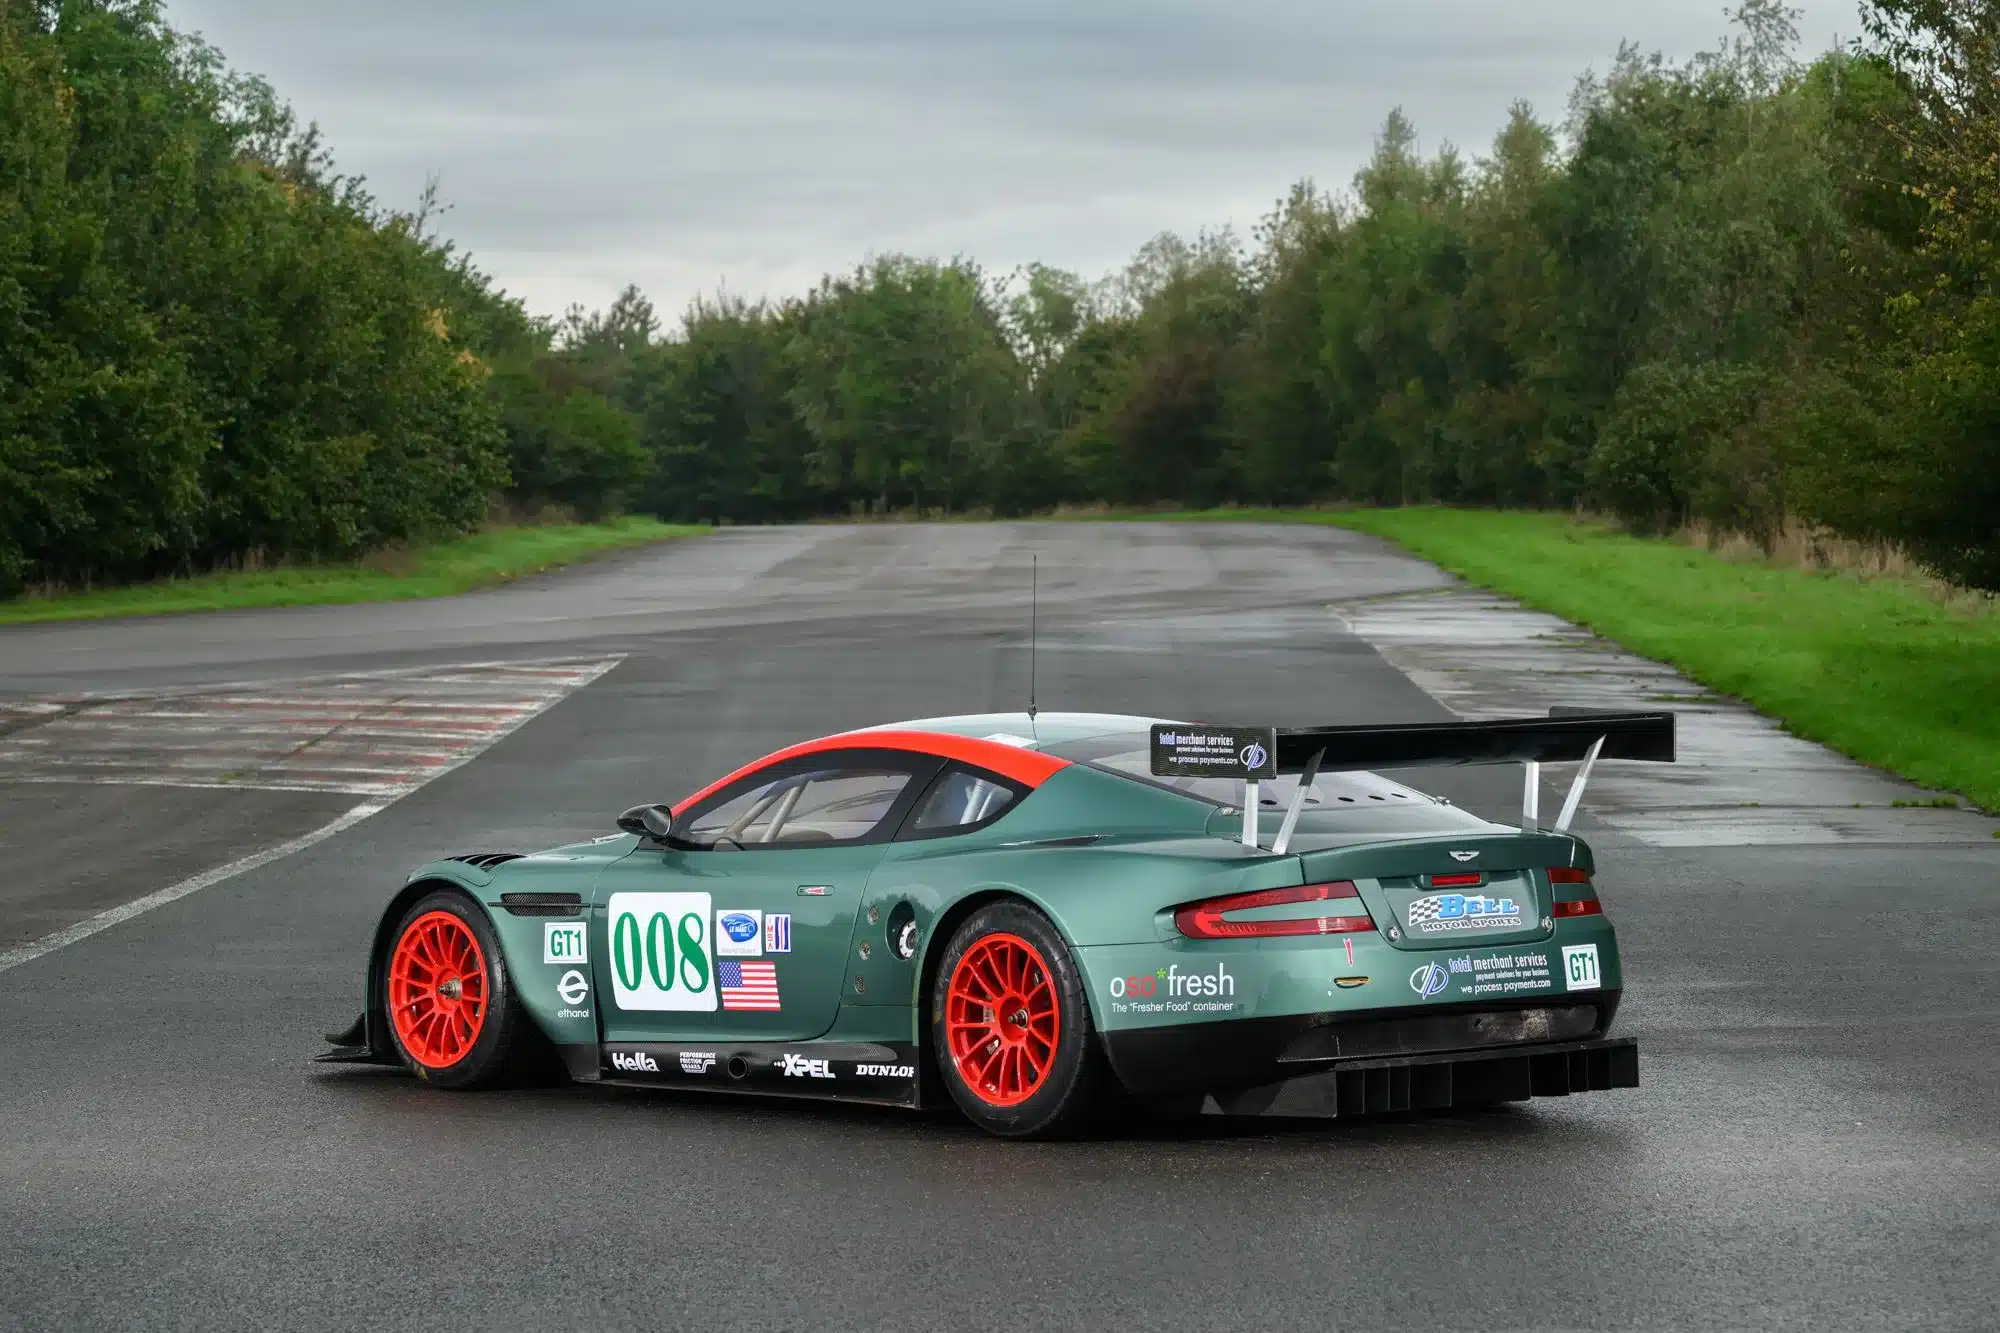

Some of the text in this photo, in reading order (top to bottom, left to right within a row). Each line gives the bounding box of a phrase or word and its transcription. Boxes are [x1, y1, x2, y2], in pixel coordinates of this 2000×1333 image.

[1159, 731, 1234, 746] total merchant services
[1178, 756, 1199, 765] process
[1200, 757, 1238, 766] payments.com
[1422, 916, 1521, 933] MOTOR SPORTS
[550, 929, 582, 957] GT1
[613, 912, 709, 993] 008
[1448, 952, 1548, 974] total merchant services
[1569, 952, 1597, 982] GT1
[1475, 972, 1496, 983] payment
[1496, 970, 1515, 980] solutions
[1522, 970, 1532, 979] your
[1531, 968, 1550, 977] business
[1460, 979, 1551, 995] we process payments.com
[557, 1008, 589, 1018] ethanol
[1112, 1001, 1234, 1013] The "Fresher Food" container
[612, 1052, 660, 1072] Hella
[680, 1051, 716, 1059] PERFORMANCE
[783, 1053, 836, 1078] XPEL
